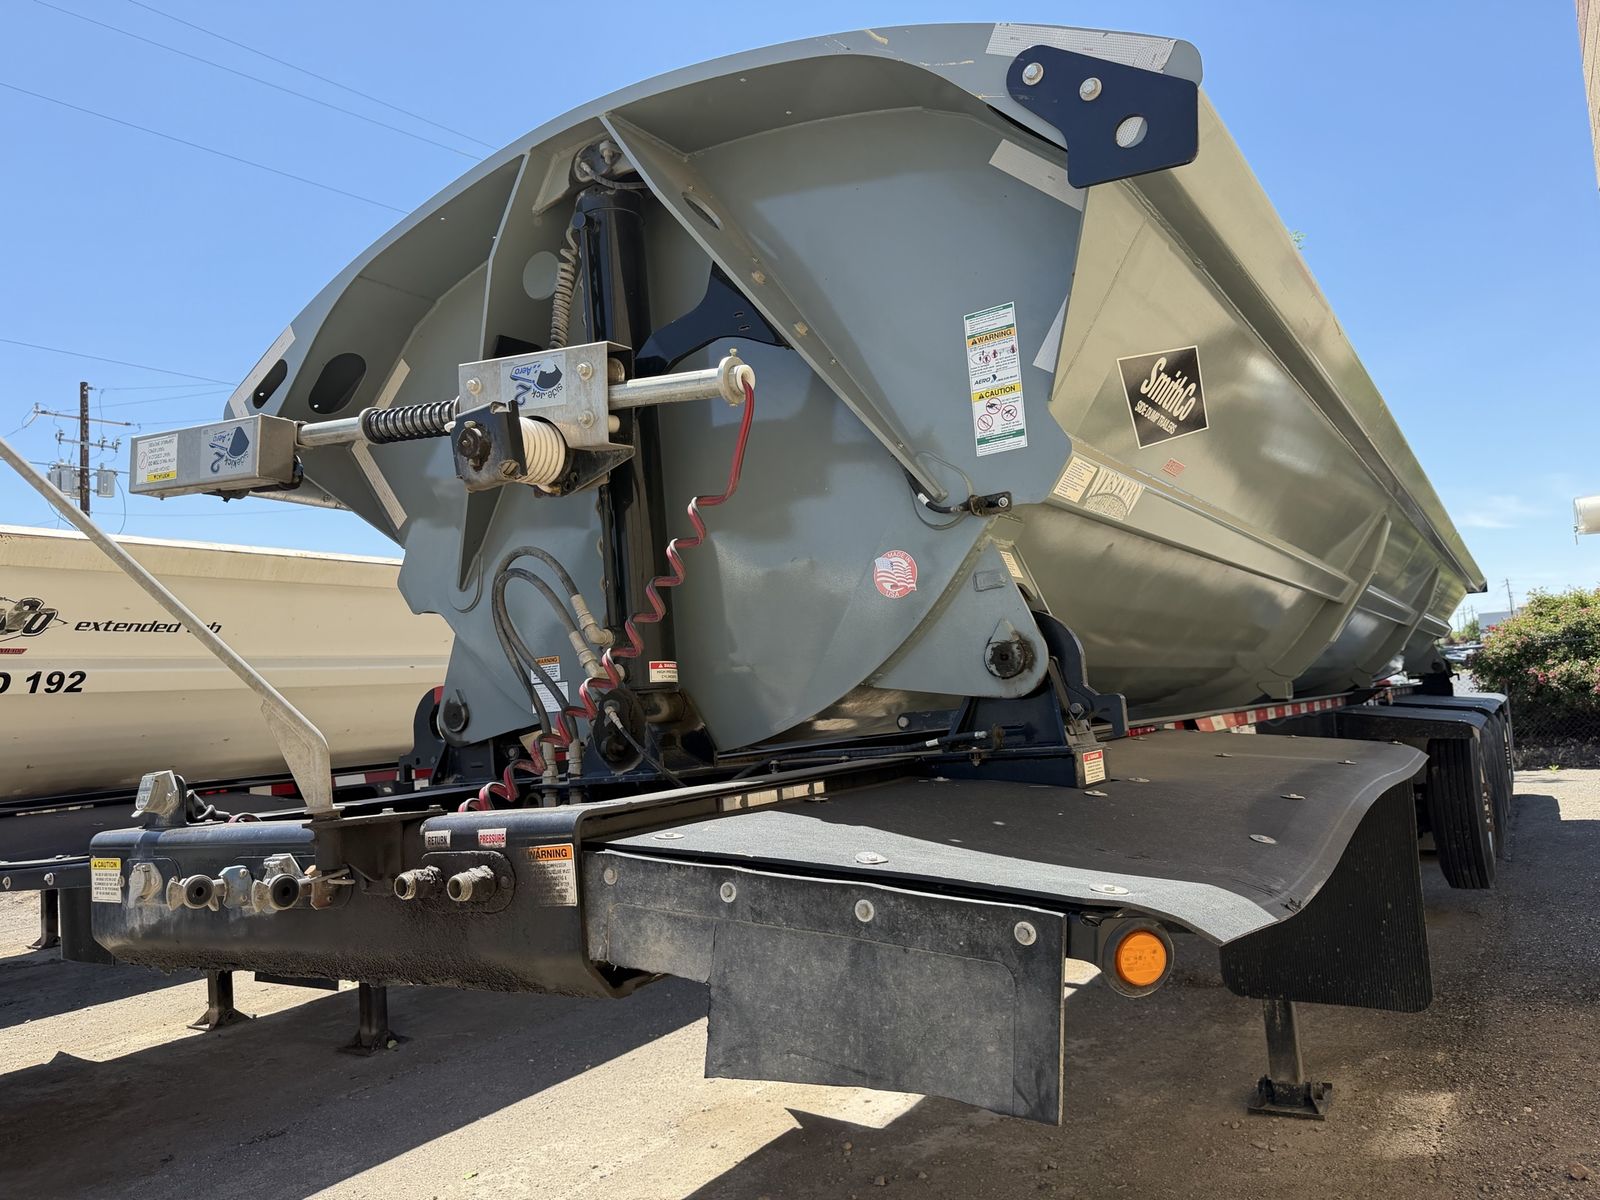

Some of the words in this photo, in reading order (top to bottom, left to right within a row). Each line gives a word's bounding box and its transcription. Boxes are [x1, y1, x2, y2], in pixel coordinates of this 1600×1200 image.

[977, 329, 1012, 343] WARNING
[514, 365, 533, 376] Aero
[974, 377, 991, 385] AERO
[984, 385, 1016, 398] CAUTION
[1140, 357, 1197, 421] SmithCo
[1134, 400, 1149, 416] SIDE
[1145, 405, 1160, 423] DUMP
[1156, 414, 1178, 435] TRAILERS
[74, 620, 182, 633] extended
[25, 670, 87, 694] 192
[427, 835, 448, 846] RETURN
[479, 833, 506, 844] PRESSURE
[528, 848, 568, 860] WARNING
